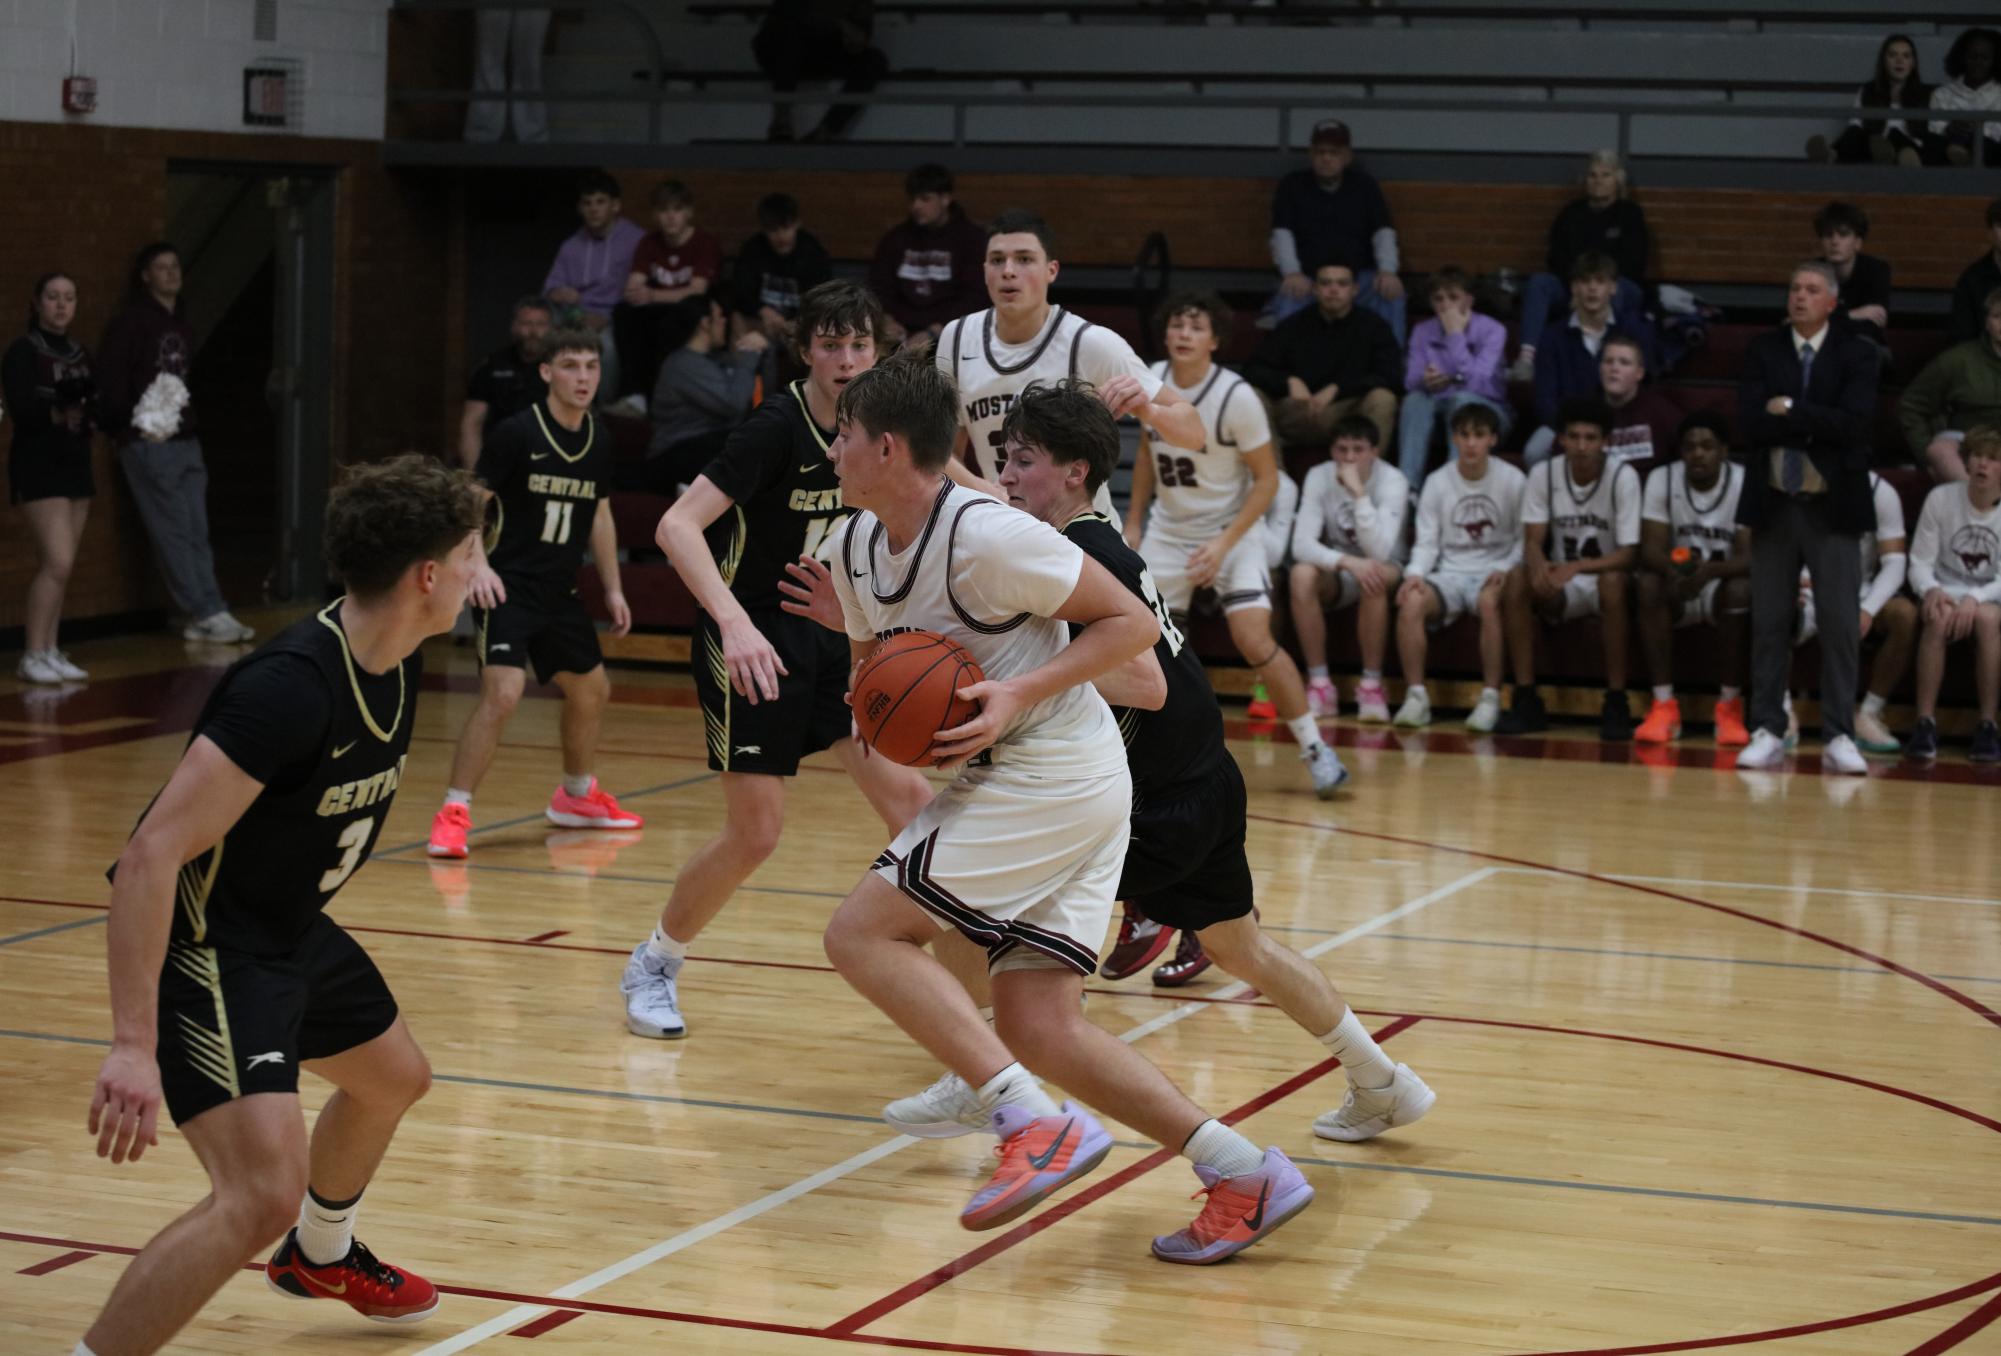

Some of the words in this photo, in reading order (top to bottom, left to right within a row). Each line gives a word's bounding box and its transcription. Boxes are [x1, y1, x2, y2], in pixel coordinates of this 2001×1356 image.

[966, 394, 1020, 423] MUST
[527, 473, 597, 500] CENTRAL
[1158, 453, 1198, 487] 22
[540, 500, 575, 545] 11
[318, 816, 374, 893] 3
